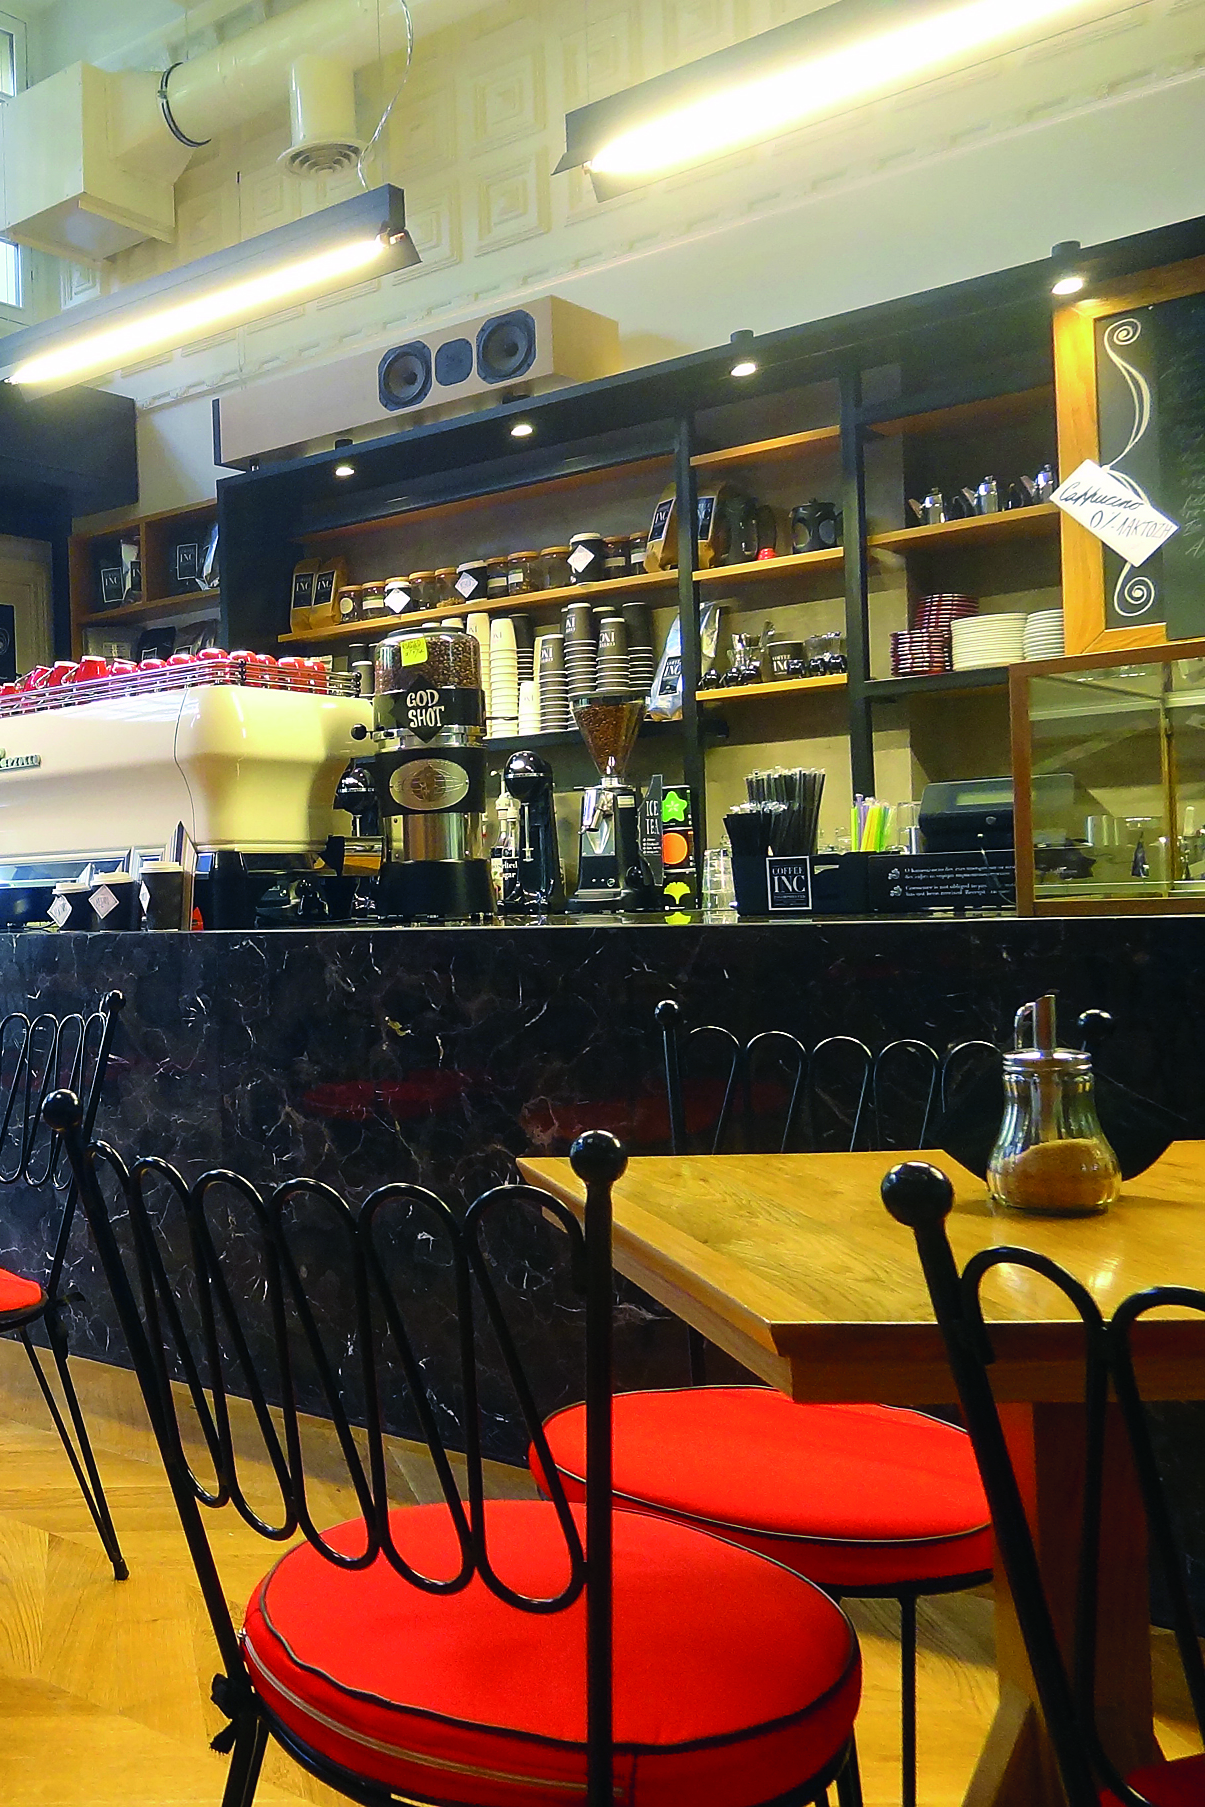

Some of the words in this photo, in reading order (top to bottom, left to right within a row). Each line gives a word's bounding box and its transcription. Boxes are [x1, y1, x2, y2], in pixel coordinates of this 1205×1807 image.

[406, 689, 440, 708] GOD
[407, 705, 445, 728] SHOT
[645, 800, 659, 817] ICE
[645, 818, 660, 835] TEA
[771, 866, 805, 876] COFFEE
[773, 875, 806, 893] INC
